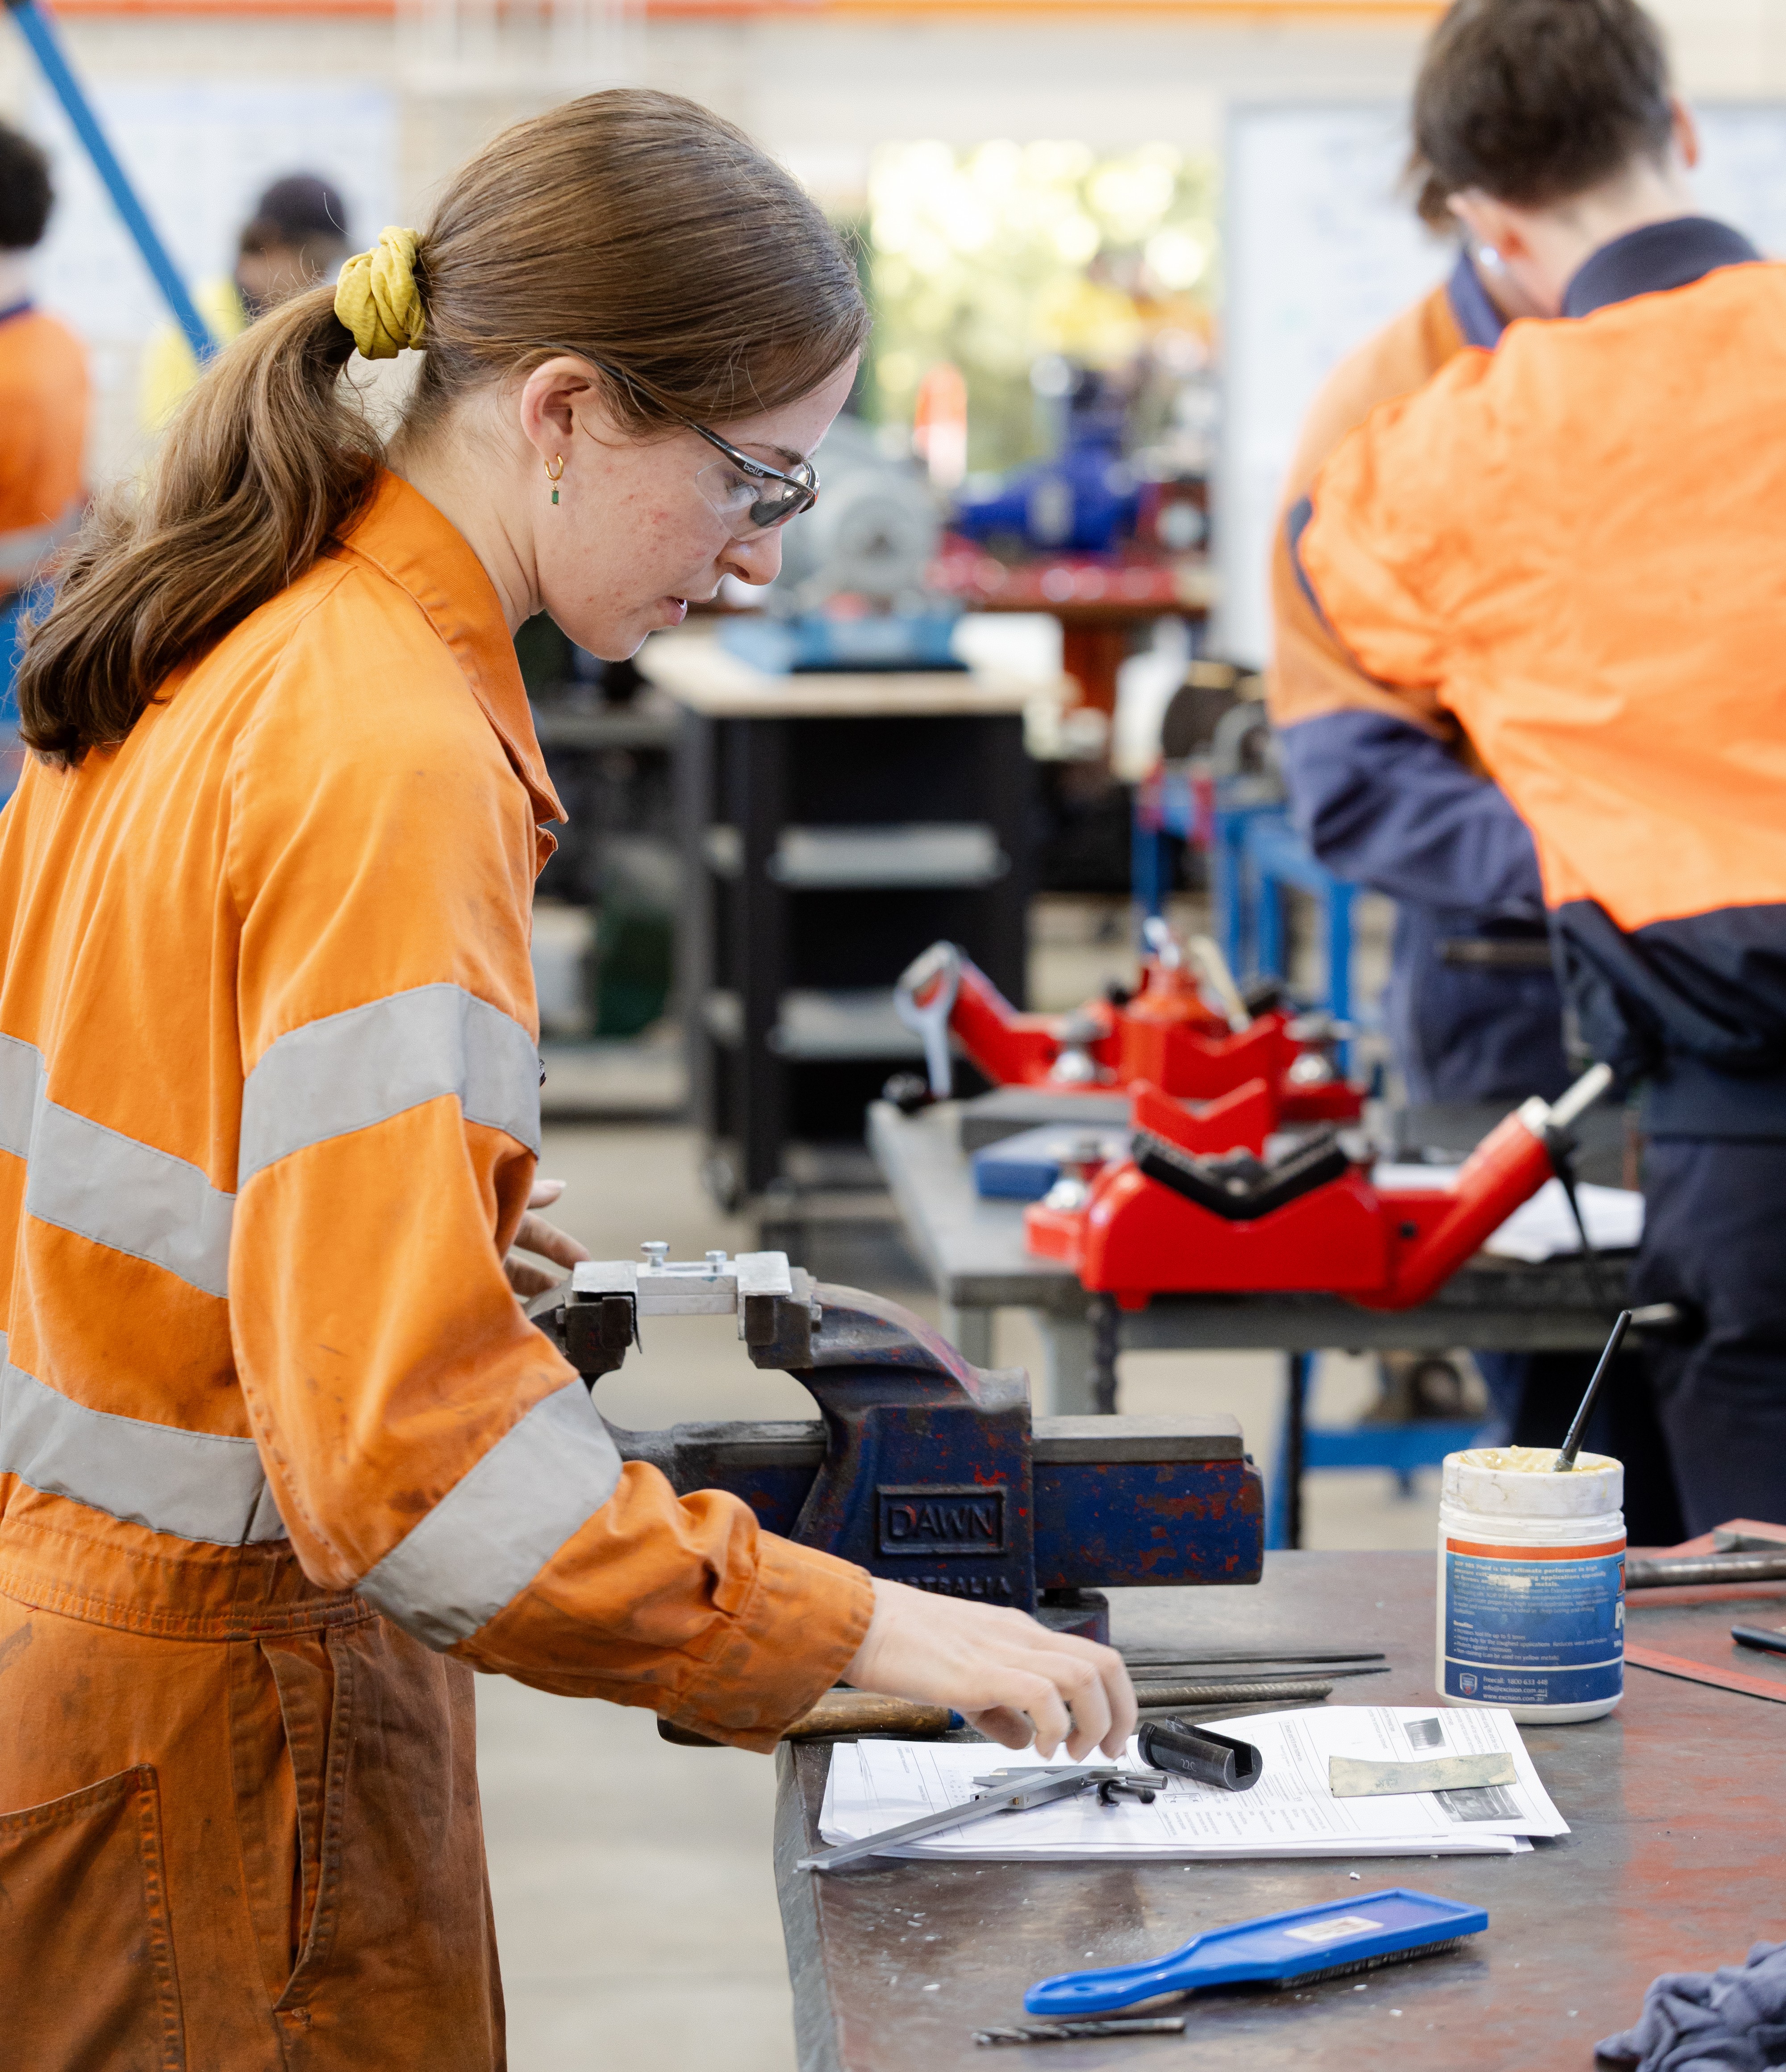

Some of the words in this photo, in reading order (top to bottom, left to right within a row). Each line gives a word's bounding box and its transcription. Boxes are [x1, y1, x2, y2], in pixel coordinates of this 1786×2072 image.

[888, 1503, 994, 1538] DAWN
[888, 1576, 1012, 1595] STRALIA
[1180, 1758, 1197, 1772] 22C
